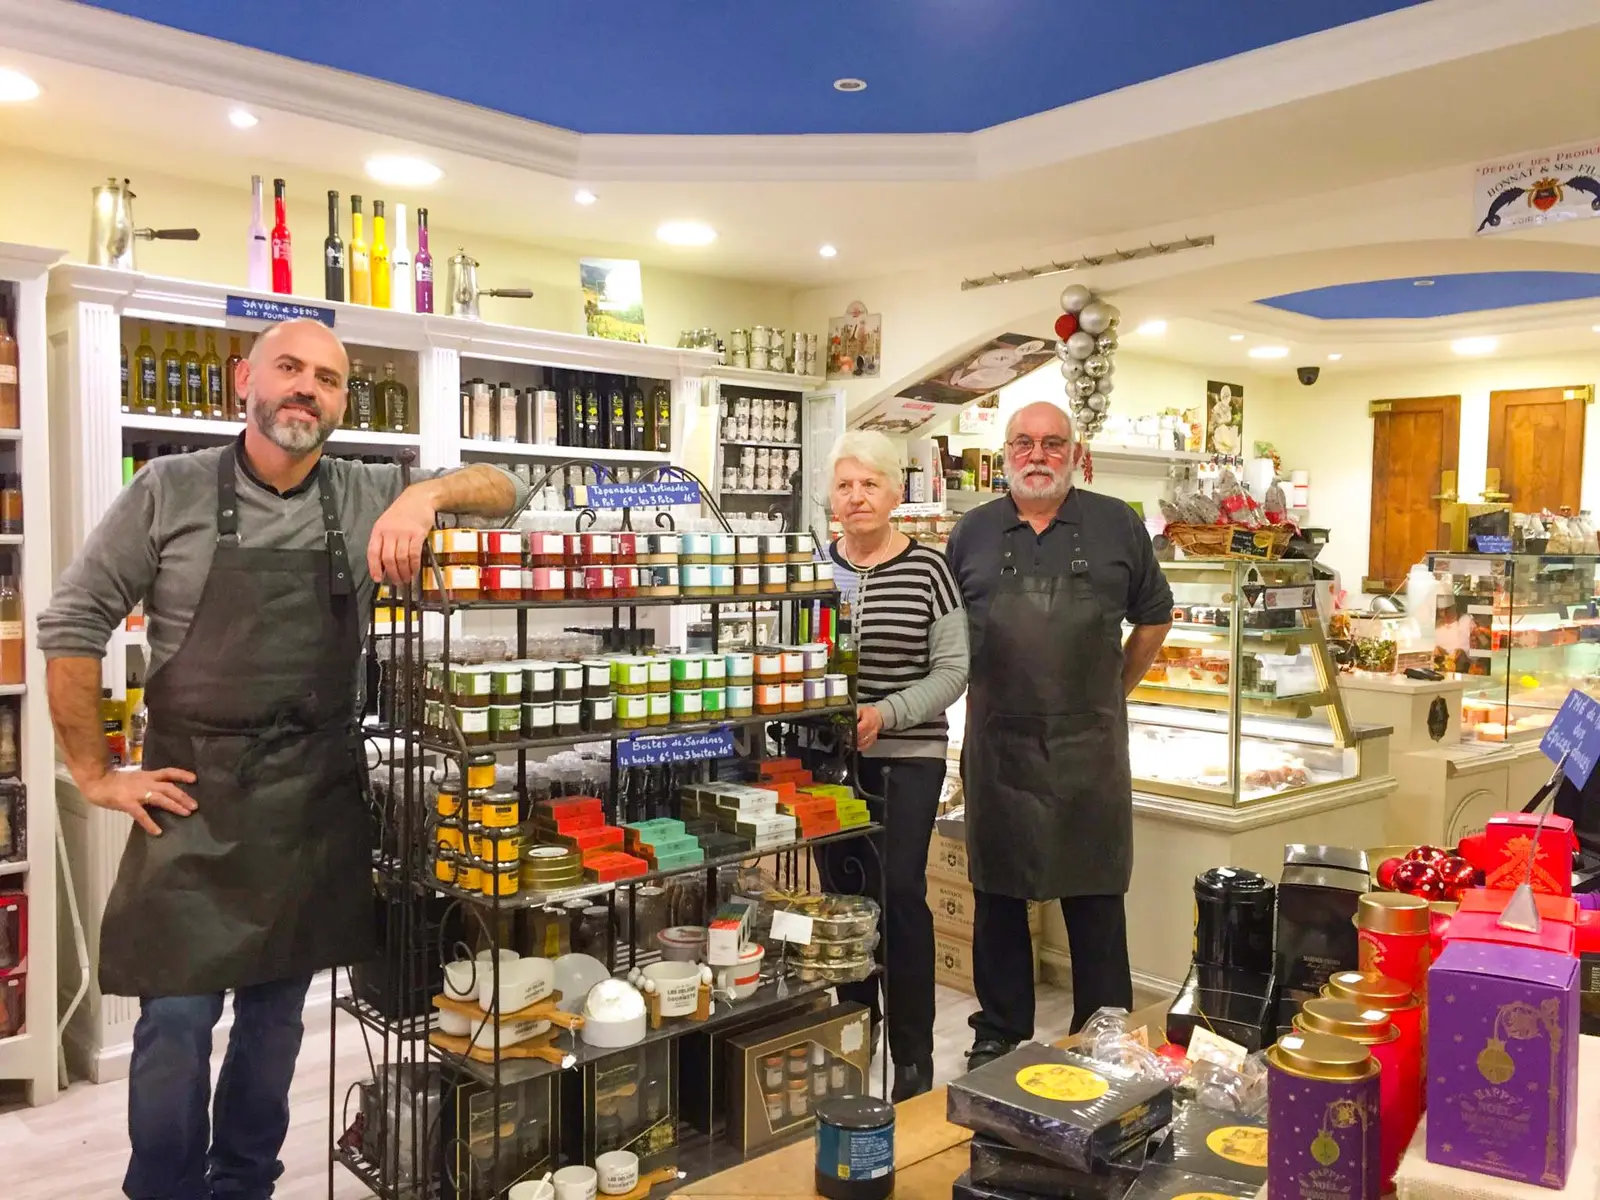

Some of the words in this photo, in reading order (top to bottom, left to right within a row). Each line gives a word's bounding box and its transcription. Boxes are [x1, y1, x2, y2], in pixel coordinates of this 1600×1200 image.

[242, 300, 279, 312] SAVOR
[292, 305, 319, 317] SENS
[602, 497, 615, 507] Pot
[650, 496, 657, 504] 3
[684, 737, 723, 746] Sardines
[673, 752, 683, 760] les
[684, 751, 691, 760] 3
